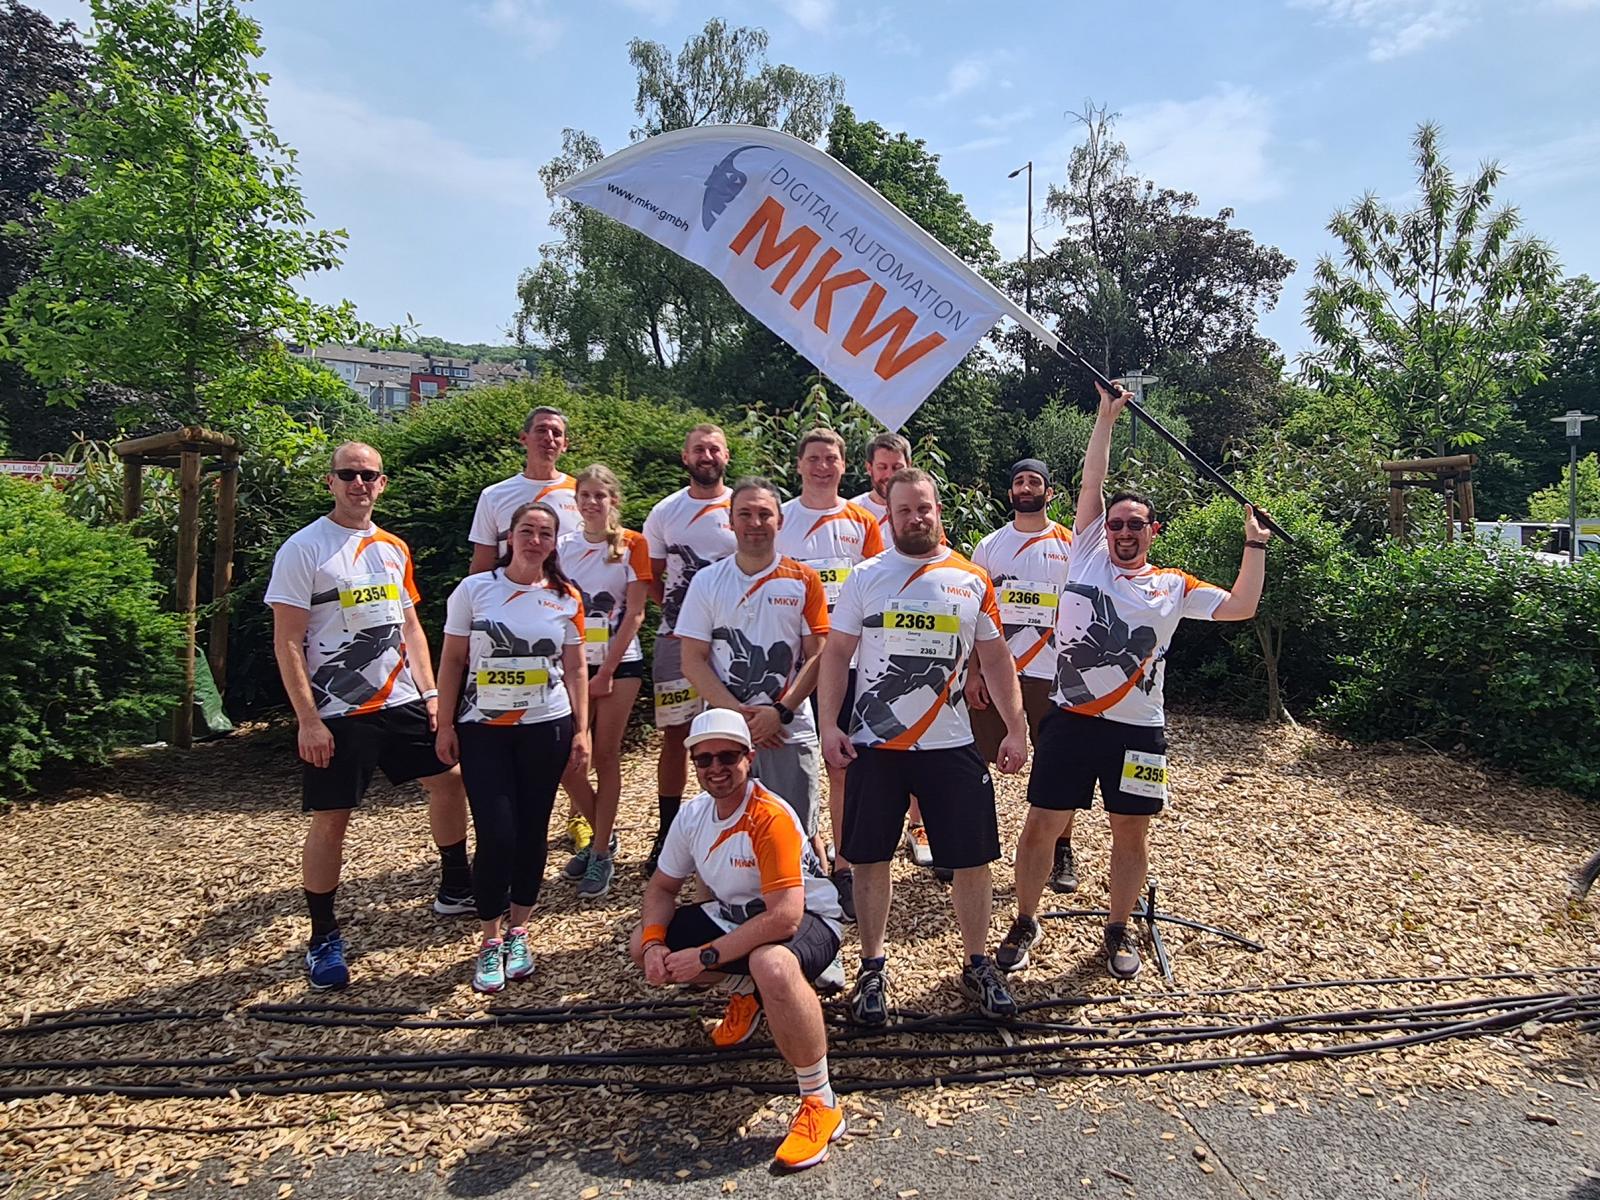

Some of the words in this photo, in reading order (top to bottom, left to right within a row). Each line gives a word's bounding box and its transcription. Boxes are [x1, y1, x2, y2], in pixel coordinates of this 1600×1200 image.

[607, 183, 689, 232] www.mkw.gmbh
[769, 168, 839, 232] DIGITAL
[840, 226, 970, 332] AUTOMATION
[729, 196, 947, 381] MKW
[819, 569, 837, 583] 53
[352, 585, 388, 604] 2354
[947, 586, 972, 598] MKW
[1008, 591, 1040, 605] 2366
[774, 597, 799, 607] MKW
[895, 613, 936, 630] 2363
[487, 671, 526, 685] 2355
[661, 689, 692, 705] 2362
[1134, 765, 1164, 783] 2359
